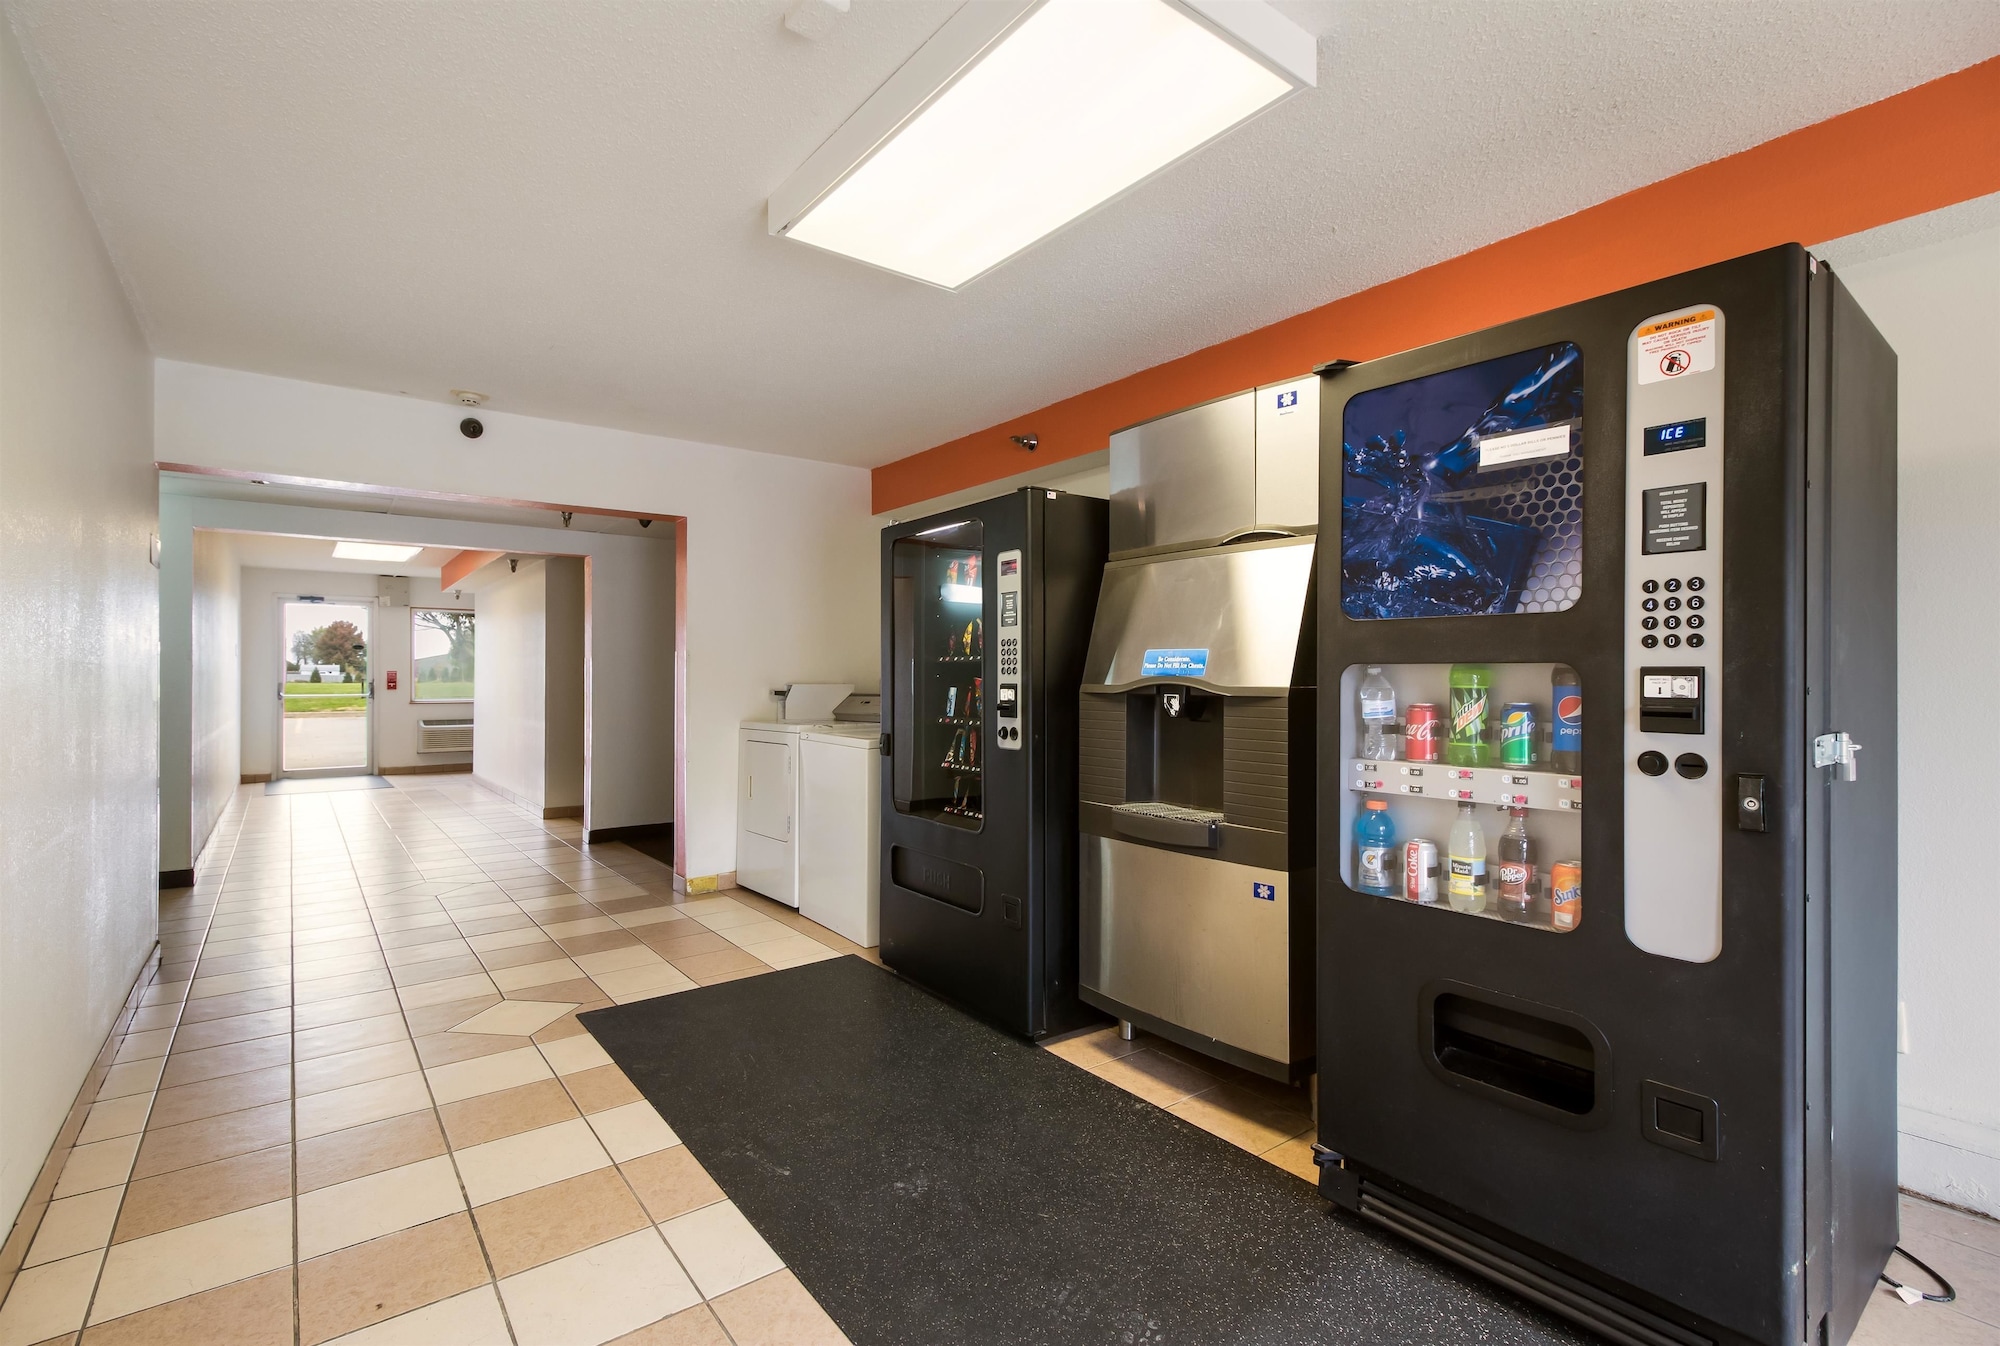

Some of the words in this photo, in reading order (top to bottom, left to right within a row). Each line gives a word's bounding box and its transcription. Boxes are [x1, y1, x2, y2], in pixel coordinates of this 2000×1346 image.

[1654, 316, 1696, 331] WARNING
[1660, 426, 1684, 440] ICE
[1648, 583, 1652, 591] 1
[1669, 581, 1676, 590] 2
[1692, 579, 1699, 589] 3
[1646, 600, 1653, 609] 4
[1669, 600, 1676, 608] 5
[1692, 598, 1699, 607] 6
[1647, 619, 1653, 627] 7
[1669, 618, 1675, 627] 8
[1691, 617, 1699, 627] 9
[1669, 637, 1675, 645] 0
[1501, 720, 1535, 742] prite
[1408, 849, 1418, 876] Coke
[1500, 868, 1525, 882] Pepper
[1507, 867, 1518, 875] Dr
